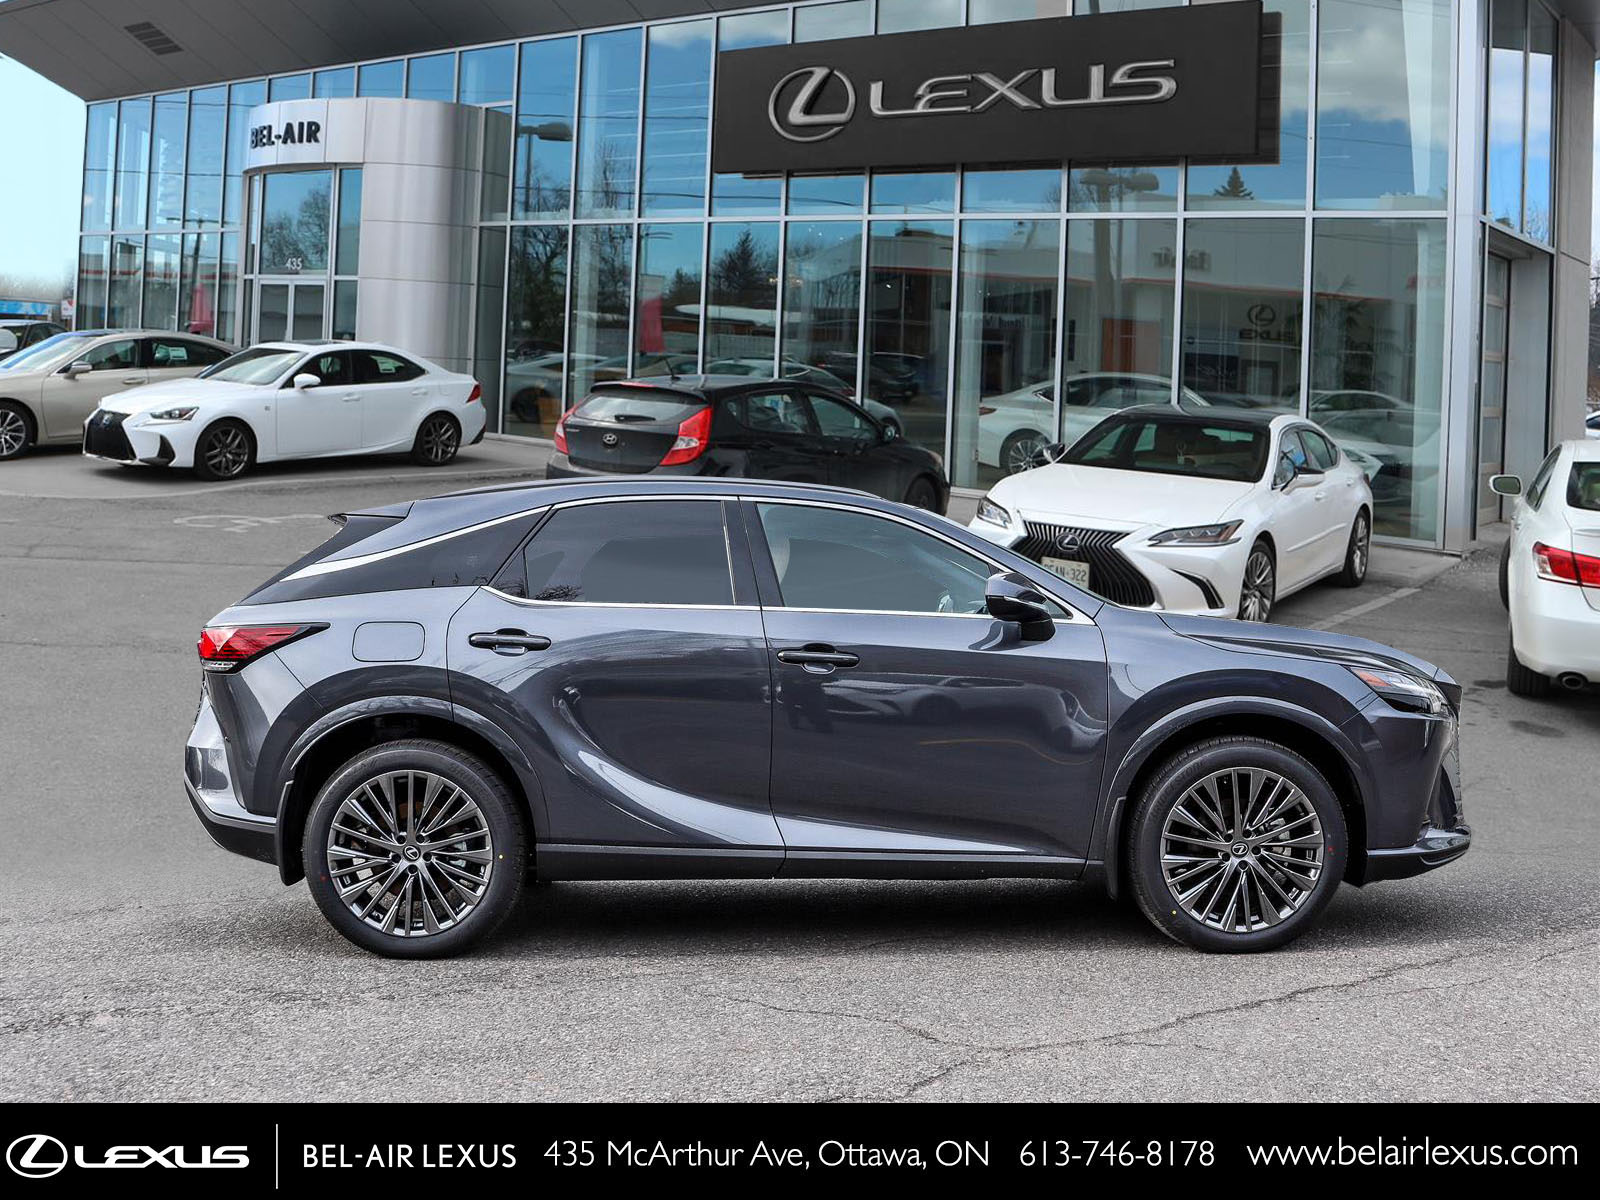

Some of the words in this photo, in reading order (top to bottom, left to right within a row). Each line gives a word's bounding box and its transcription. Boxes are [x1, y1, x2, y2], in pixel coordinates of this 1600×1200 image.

[869, 58, 1178, 118] LEXUS
[250, 120, 321, 149] BEL-AIR
[286, 257, 302, 270] 435
